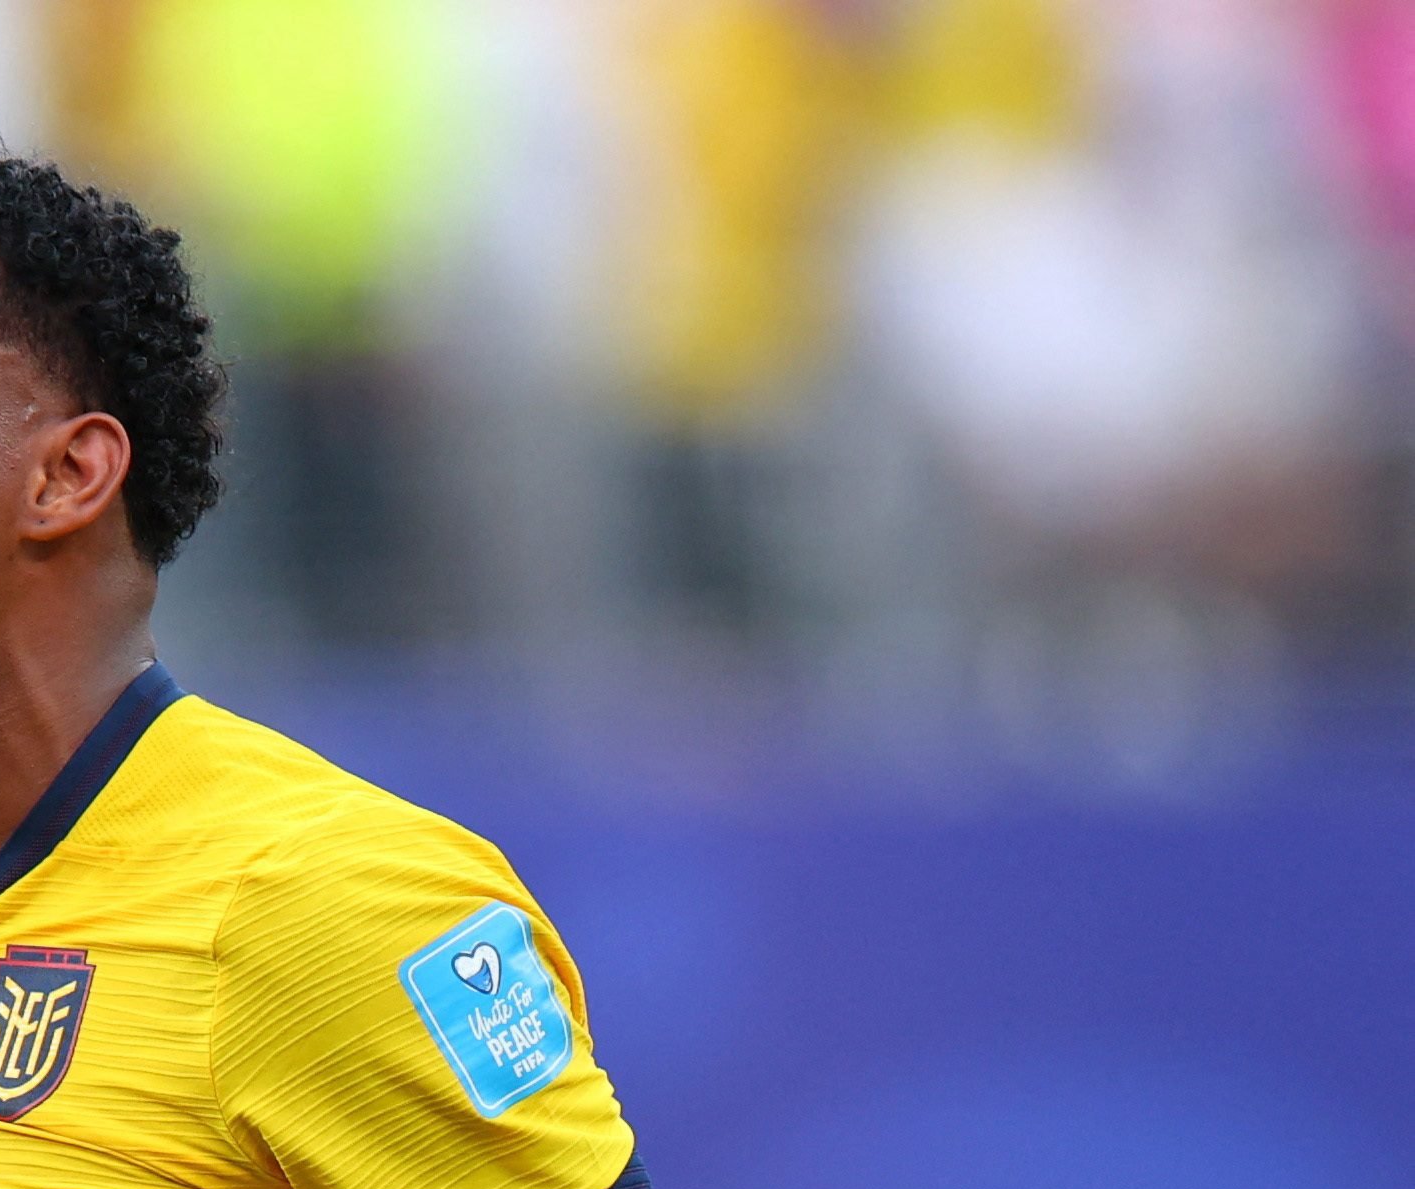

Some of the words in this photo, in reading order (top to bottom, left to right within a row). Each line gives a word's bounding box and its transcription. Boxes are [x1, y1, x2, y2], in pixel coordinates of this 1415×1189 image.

[468, 998, 514, 1041] Unite
[507, 981, 534, 1016] For
[485, 1009, 546, 1068] PEACE
[512, 1049, 547, 1079] FIFA
